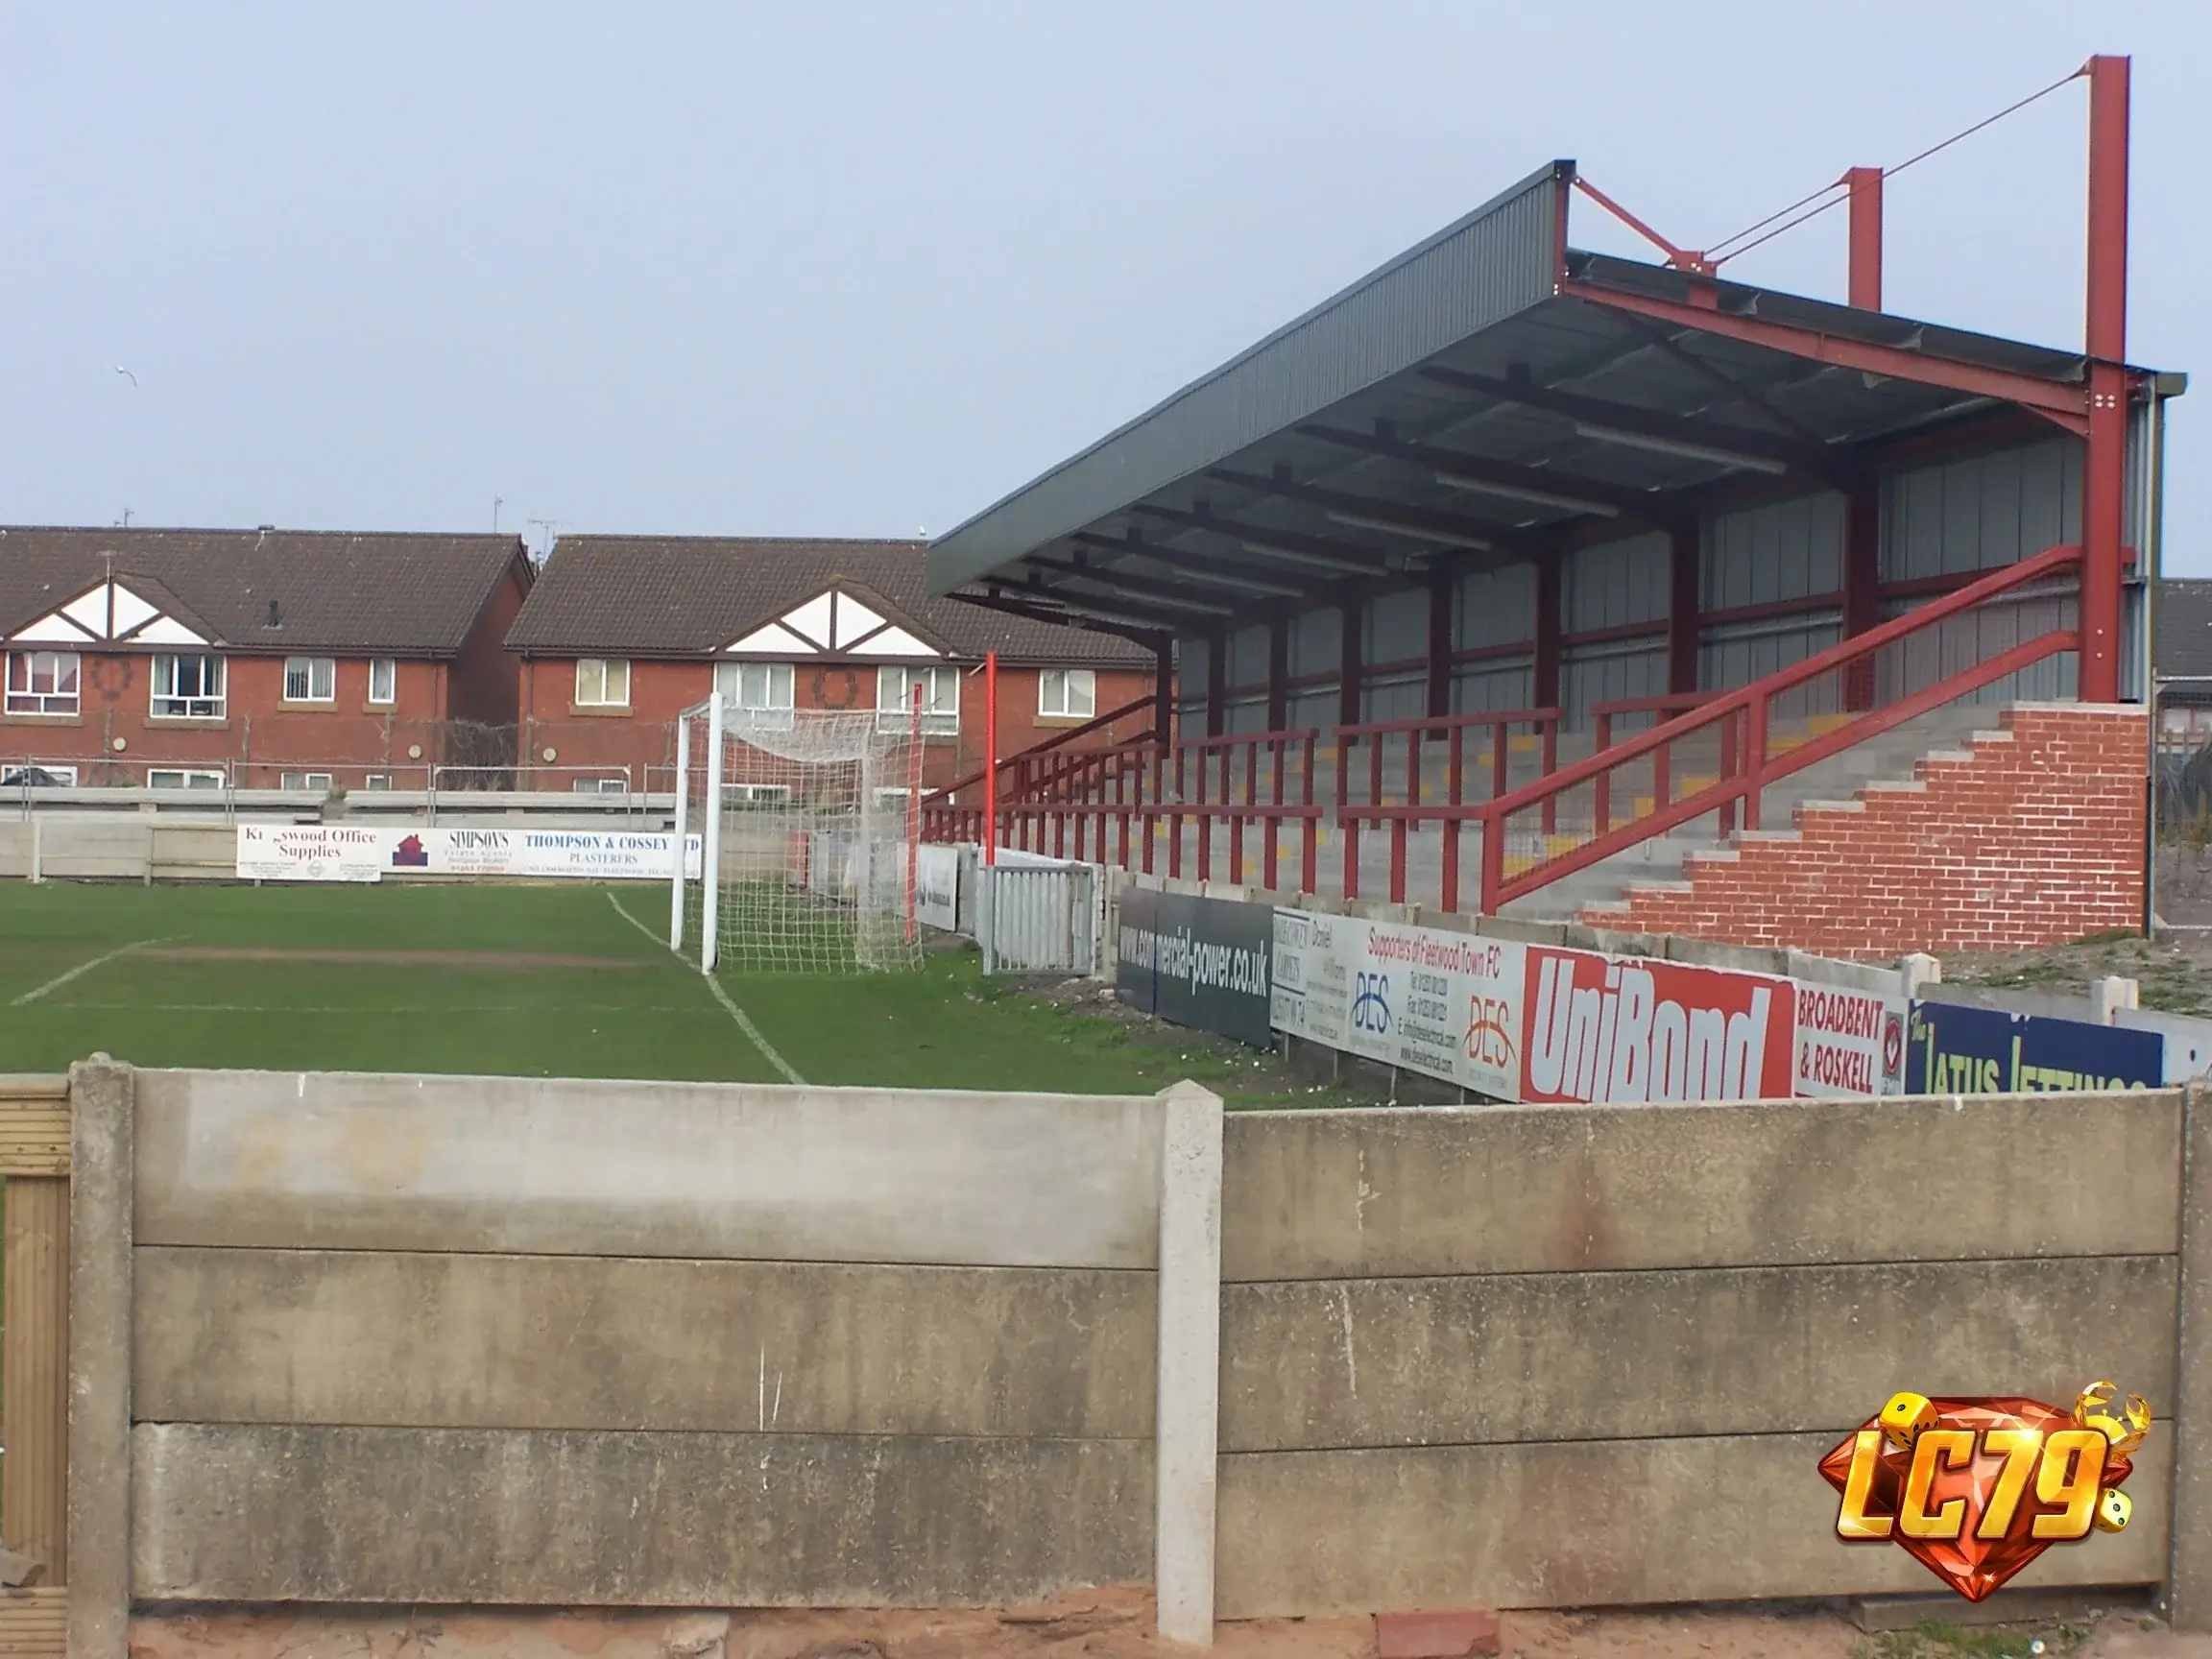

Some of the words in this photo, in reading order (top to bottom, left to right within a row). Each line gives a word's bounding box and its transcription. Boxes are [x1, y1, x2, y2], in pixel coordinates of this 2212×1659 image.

[278, 844, 342, 860] Supplies
[331, 829, 377, 843] Office
[526, 834, 601, 849] THOMPSON
[605, 837, 614, 849] &
[618, 837, 670, 851] COSSEY
[569, 853, 638, 864] PLASTERERS
[1368, 926, 1411, 965] Supporters
[1412, 933, 1421, 963] of
[1421, 933, 1460, 972] Fleetwood
[1460, 941, 1484, 976] Town
[1486, 945, 1502, 978] FC
[1354, 971, 1390, 1034] DES
[1798, 989, 1884, 1040] BROADBENT
[1469, 995, 1510, 1069] DES
[1530, 956, 1772, 1103] UniBond
[1799, 1042, 1810, 1080] &
[1813, 1044, 1873, 1095] ROSKELL
